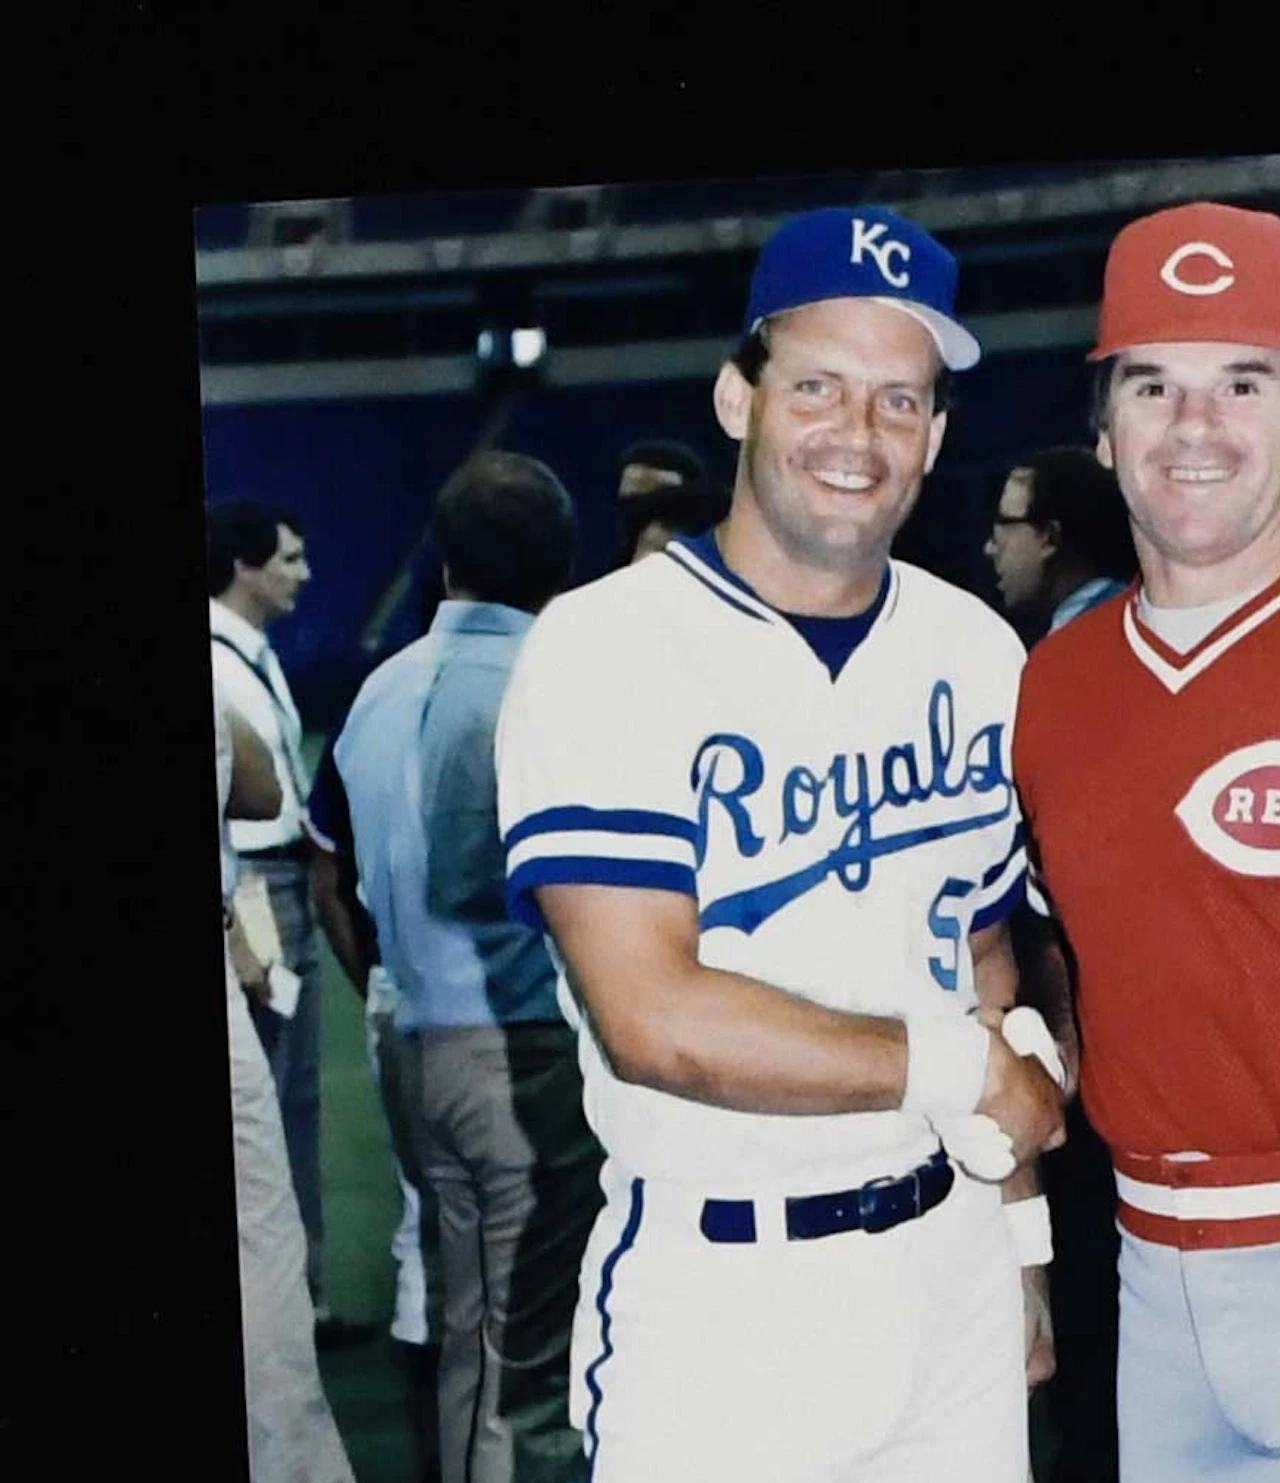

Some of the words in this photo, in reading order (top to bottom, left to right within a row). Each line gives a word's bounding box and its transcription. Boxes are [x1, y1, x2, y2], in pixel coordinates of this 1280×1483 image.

[849, 218, 910, 288] KC
[1160, 241, 1234, 295] C
[690, 680, 1012, 891] Royals
[928, 876, 977, 992] 5
